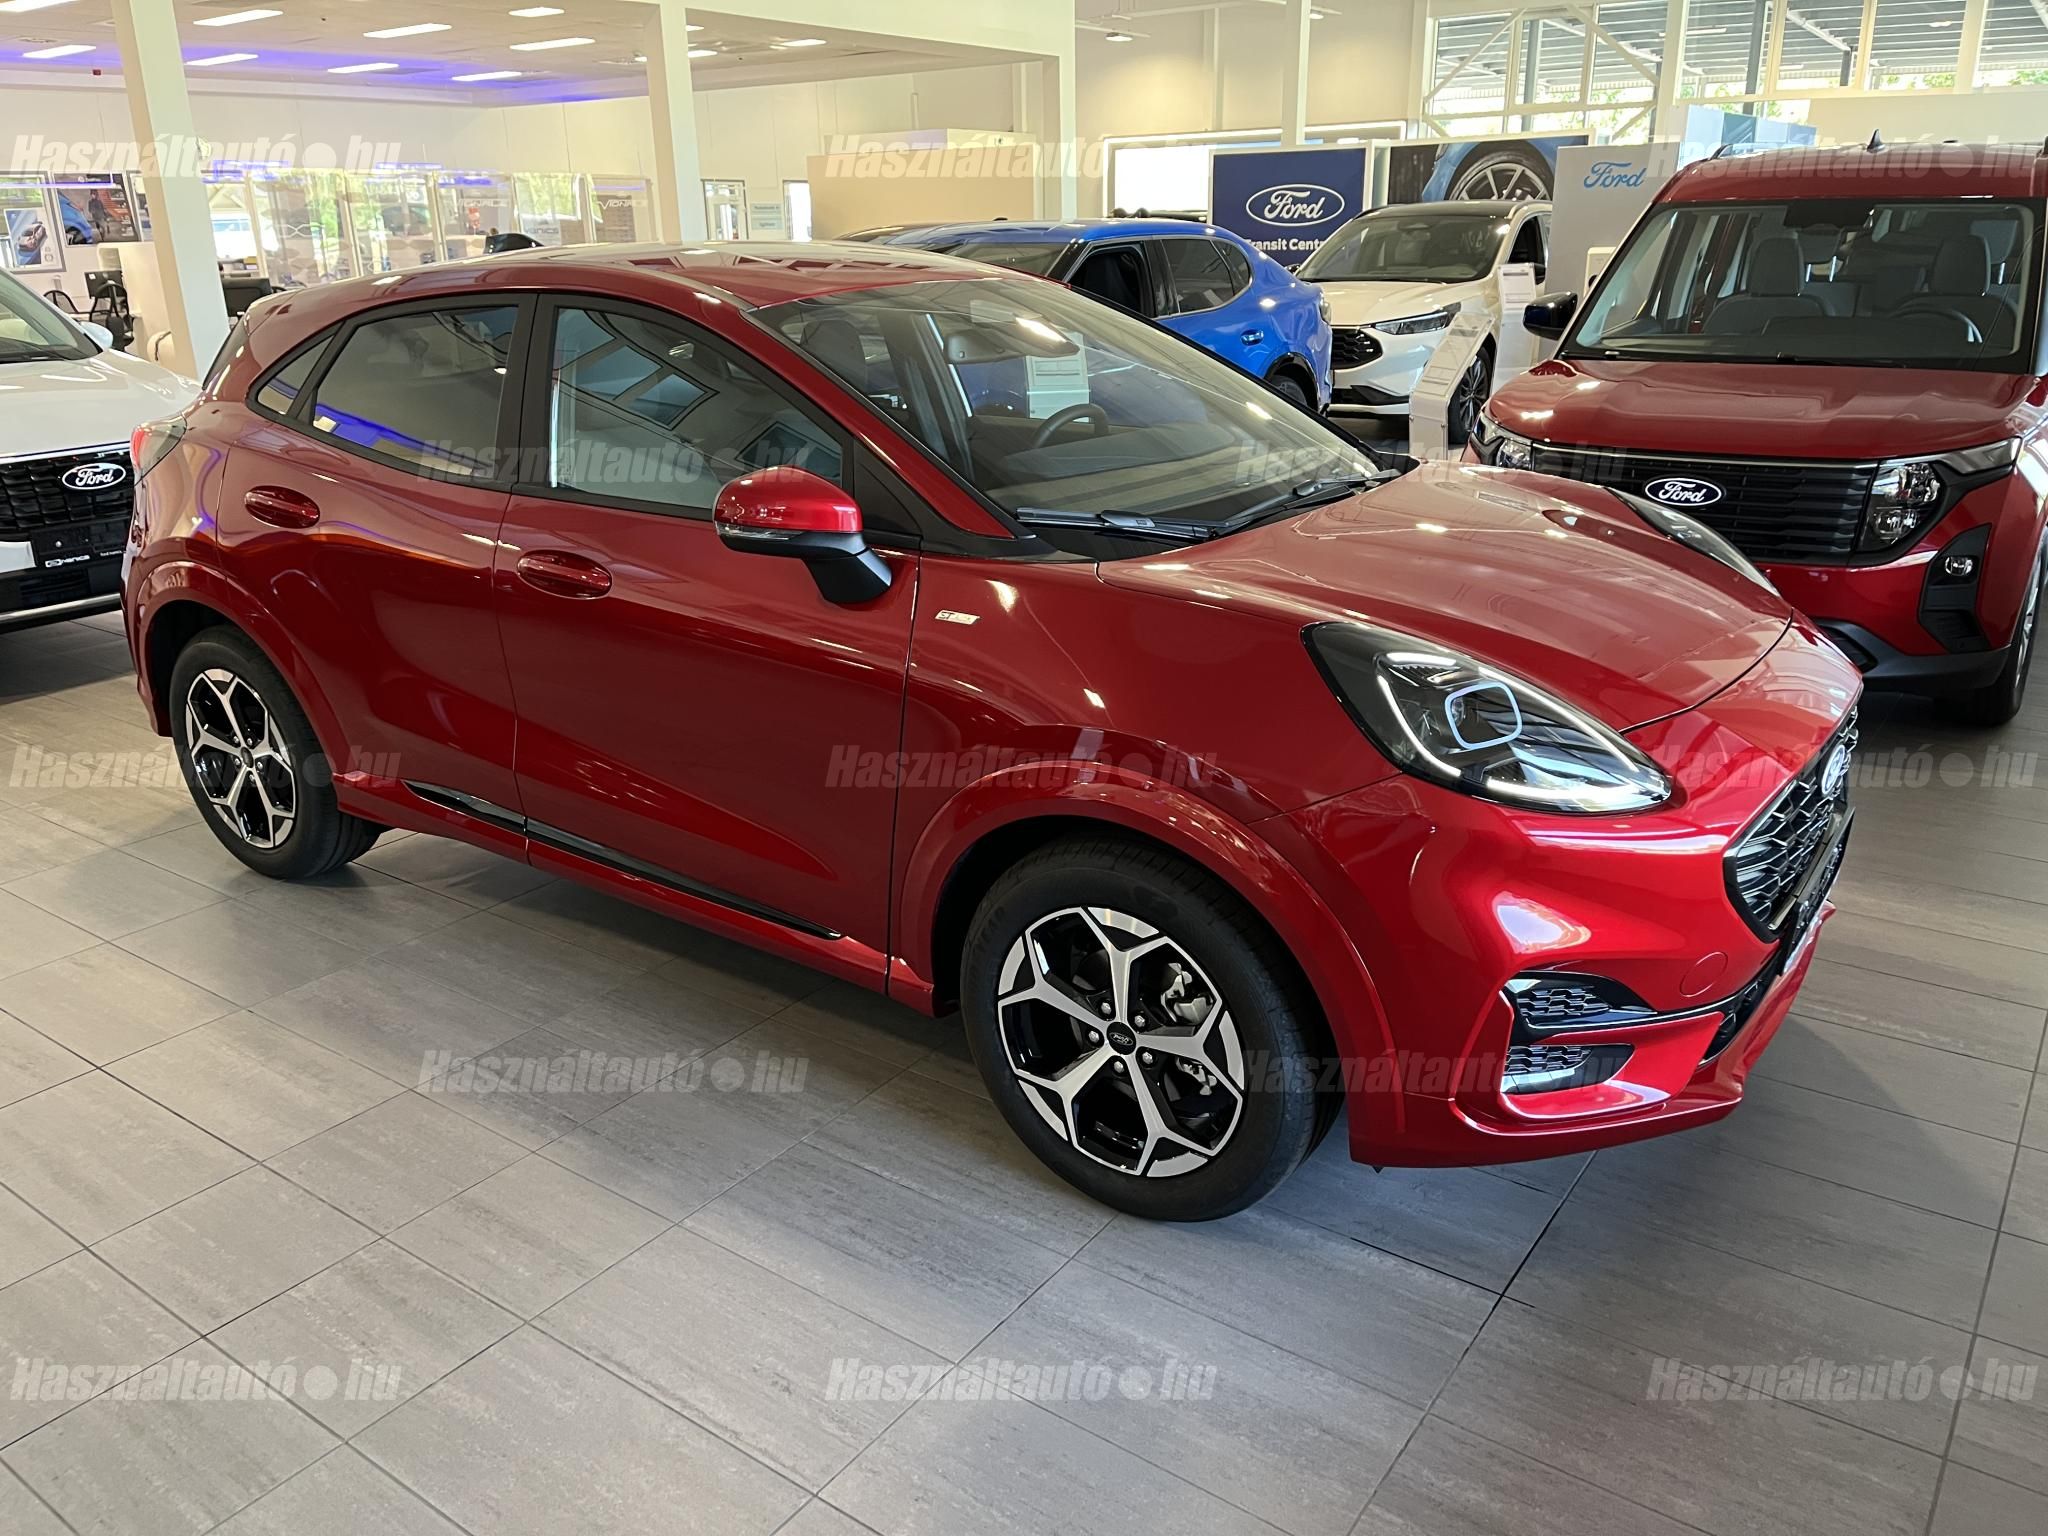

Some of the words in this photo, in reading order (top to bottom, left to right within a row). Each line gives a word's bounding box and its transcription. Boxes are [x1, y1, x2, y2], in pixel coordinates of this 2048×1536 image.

[1584, 161, 1647, 188] Ford
[1264, 190, 1326, 219] Ford
[75, 466, 114, 486] Ford
[1658, 481, 1707, 503] Ford
